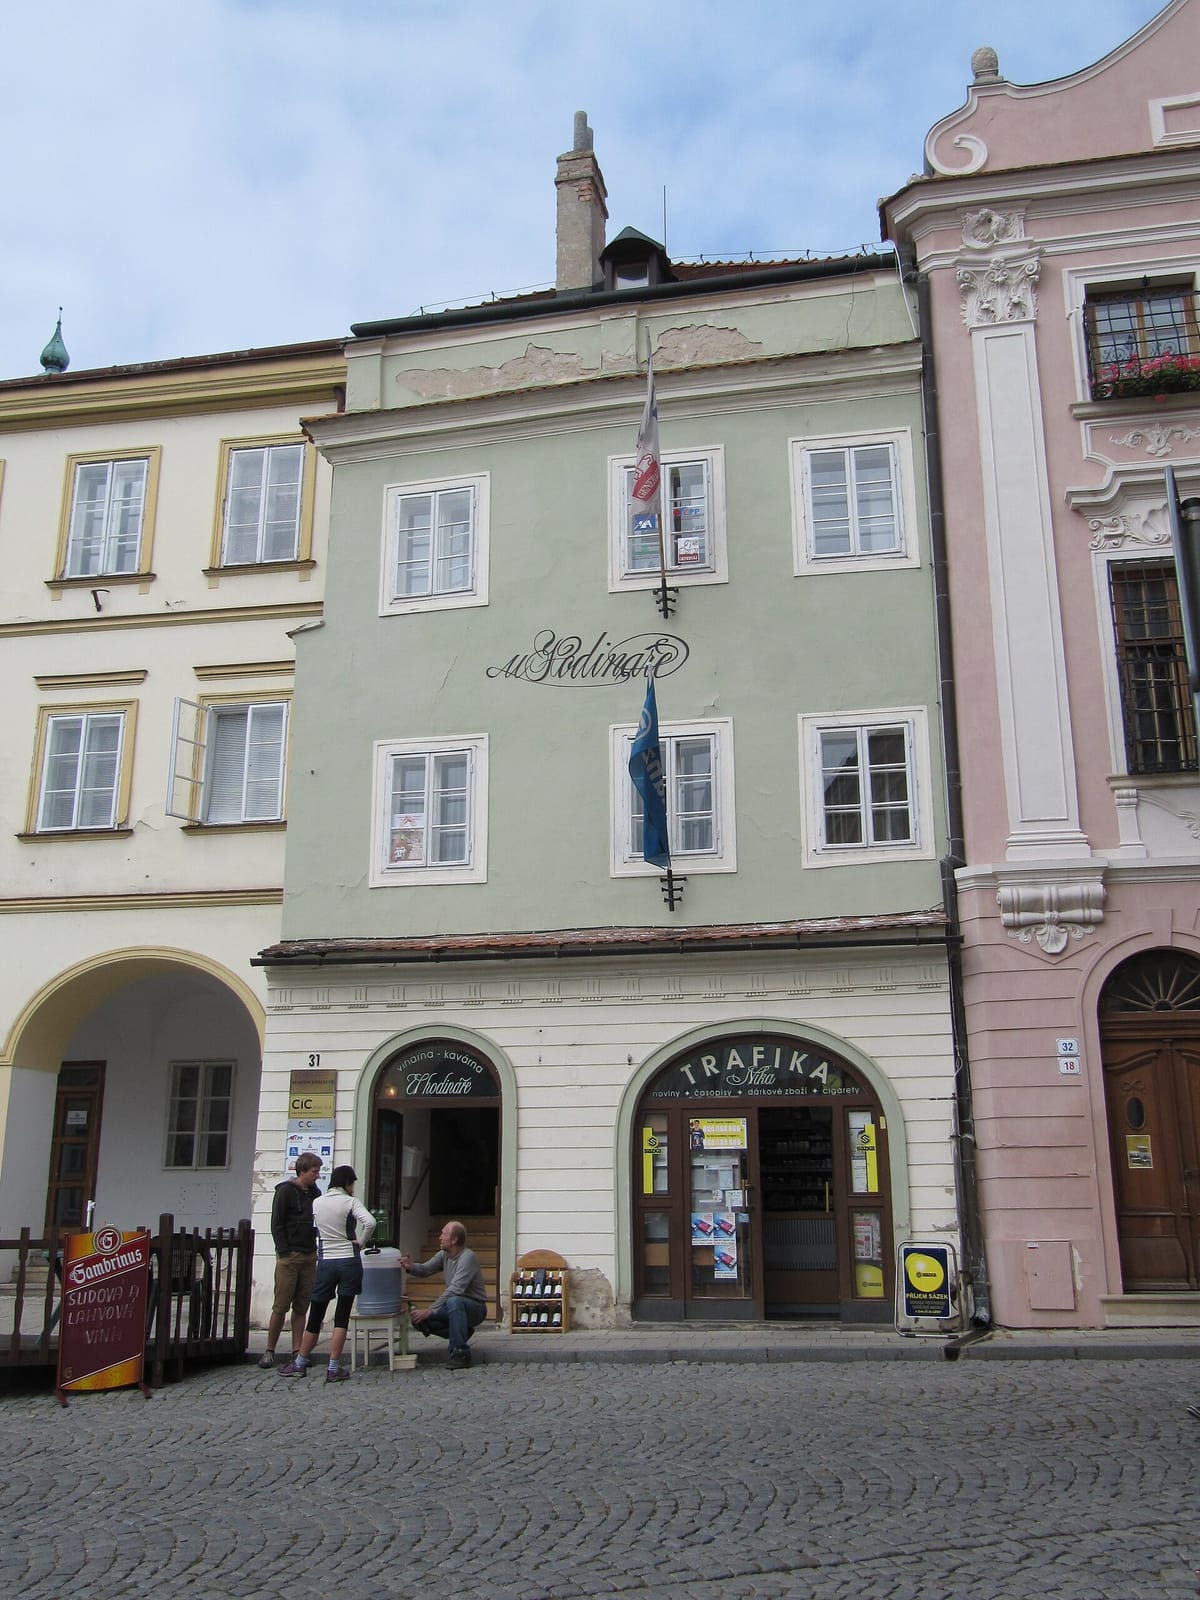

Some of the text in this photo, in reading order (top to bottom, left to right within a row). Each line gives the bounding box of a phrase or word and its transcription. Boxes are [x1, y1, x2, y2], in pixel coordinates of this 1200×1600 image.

[634, 520, 653, 530] AXA
[1062, 1042, 1074, 1052] 32
[308, 1053, 321, 1067] 31
[444, 1050, 484, 1074] kavárna
[679, 1046, 829, 1085] TRAFIKA
[1064, 1061, 1075, 1071] 18
[726, 1065, 776, 1086] Nika
[652, 1086, 860, 1098] noviny časopisy dárkové zboží cigarety
[69, 1248, 143, 1285] Gambrinus
